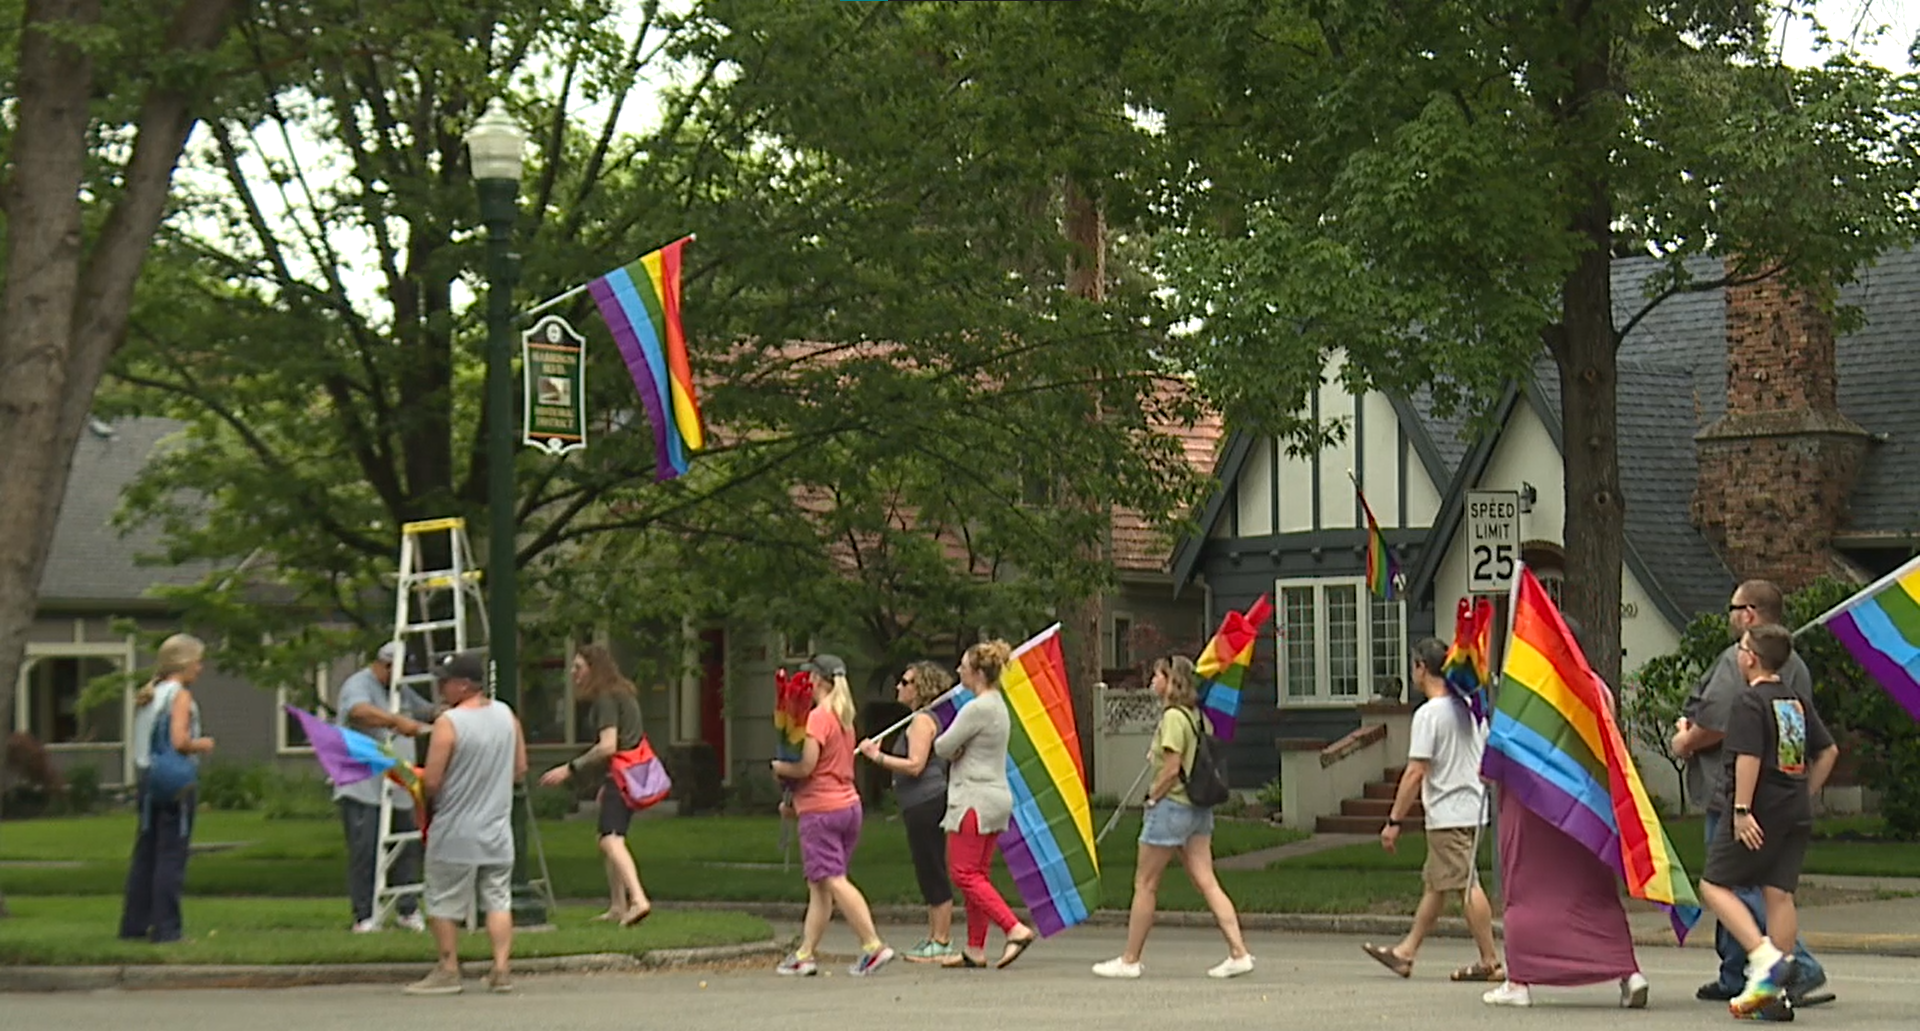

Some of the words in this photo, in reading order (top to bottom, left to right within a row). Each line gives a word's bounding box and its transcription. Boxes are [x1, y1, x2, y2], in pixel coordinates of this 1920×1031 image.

[1471, 503, 1515, 518] SPEED
[1476, 524, 1510, 540] LIMIT
[1473, 545, 1514, 580] 25
